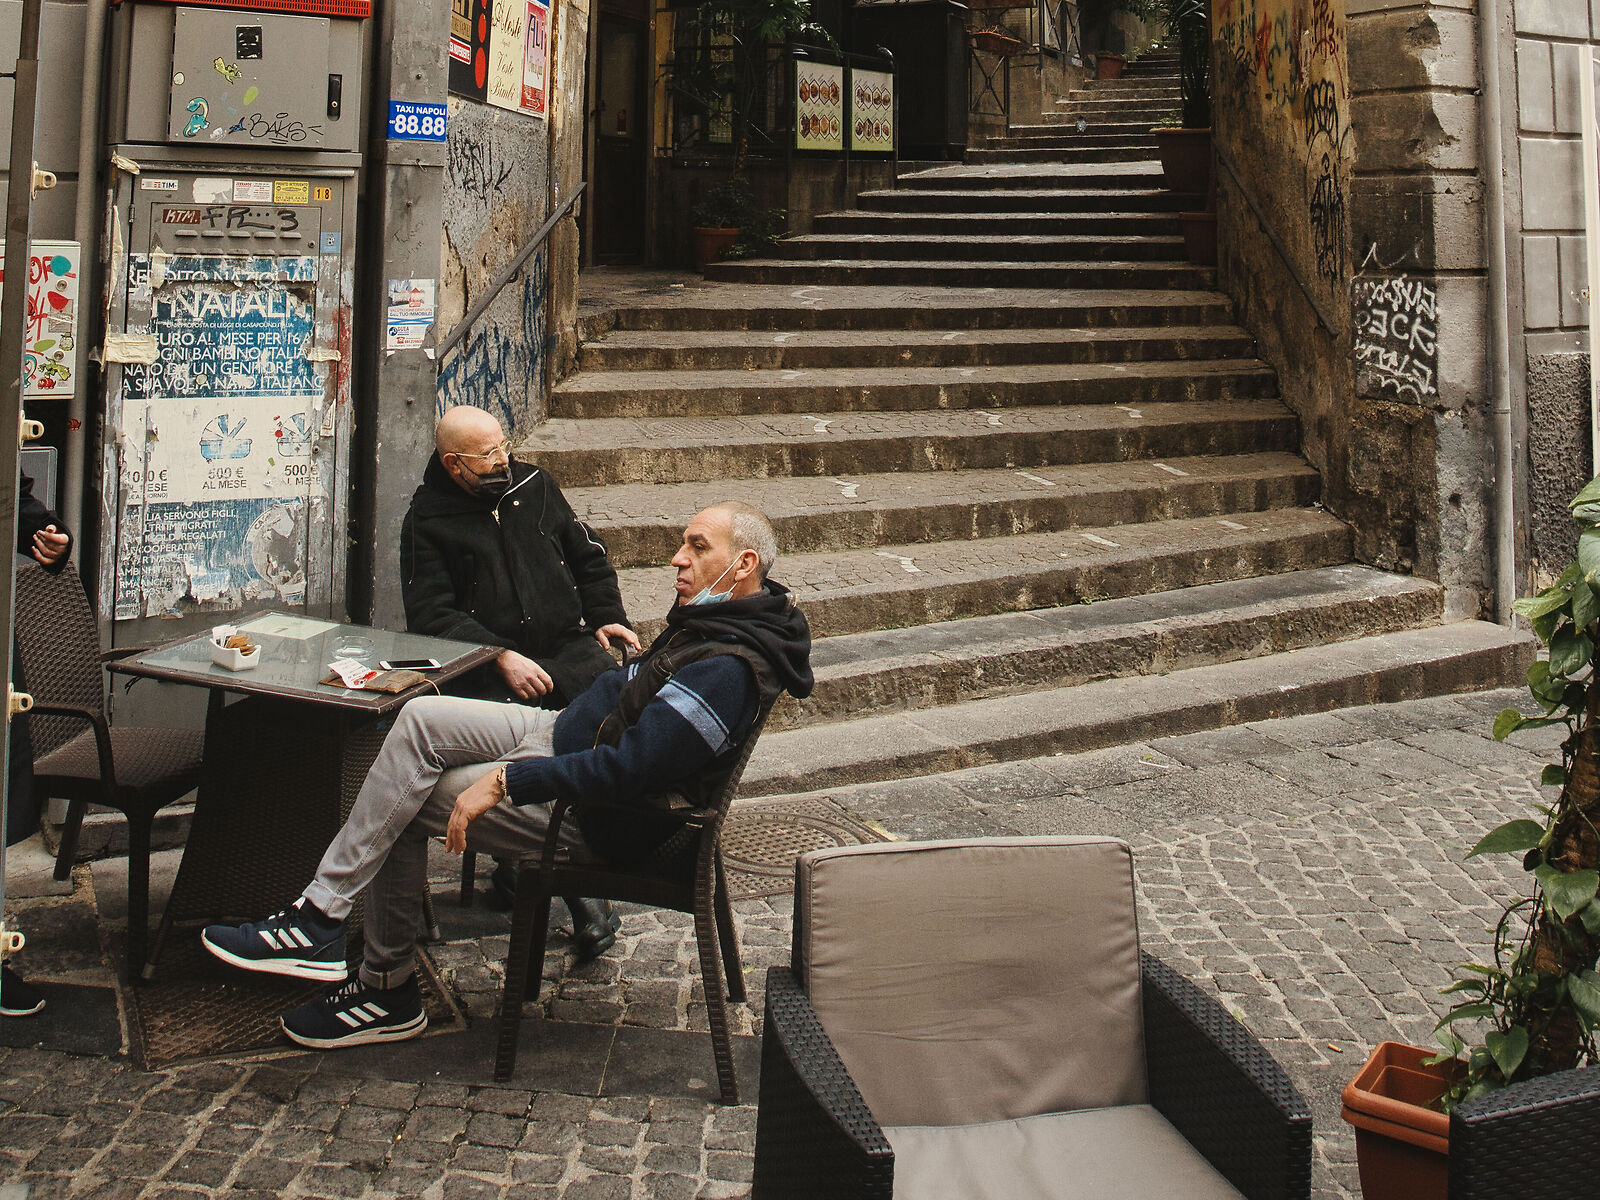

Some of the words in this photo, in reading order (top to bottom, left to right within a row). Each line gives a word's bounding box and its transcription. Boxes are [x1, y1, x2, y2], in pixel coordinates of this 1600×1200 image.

[395, 104, 414, 113] TAXI
[416, 106, 446, 116] NAPOLI
[394, 113, 446, 137] 88.88
[316, 188, 330, 200] 18
[196, 331, 215, 346] AL
[219, 332, 254, 346] MESE
[257, 332, 281, 346] PER
[287, 332, 300, 345] 16
[192, 346, 261, 361] BAMBINO
[124, 362, 163, 377] NAO
[193, 361, 216, 375] UN
[214, 375, 257, 390] NAO
[126, 469, 155, 483] 100
[284, 464, 308, 476] 500
[202, 480, 217, 490] AL
[218, 479, 247, 489] MESE
[163, 510, 209, 521] SERVONO
[182, 530, 227, 541] REGALATI
